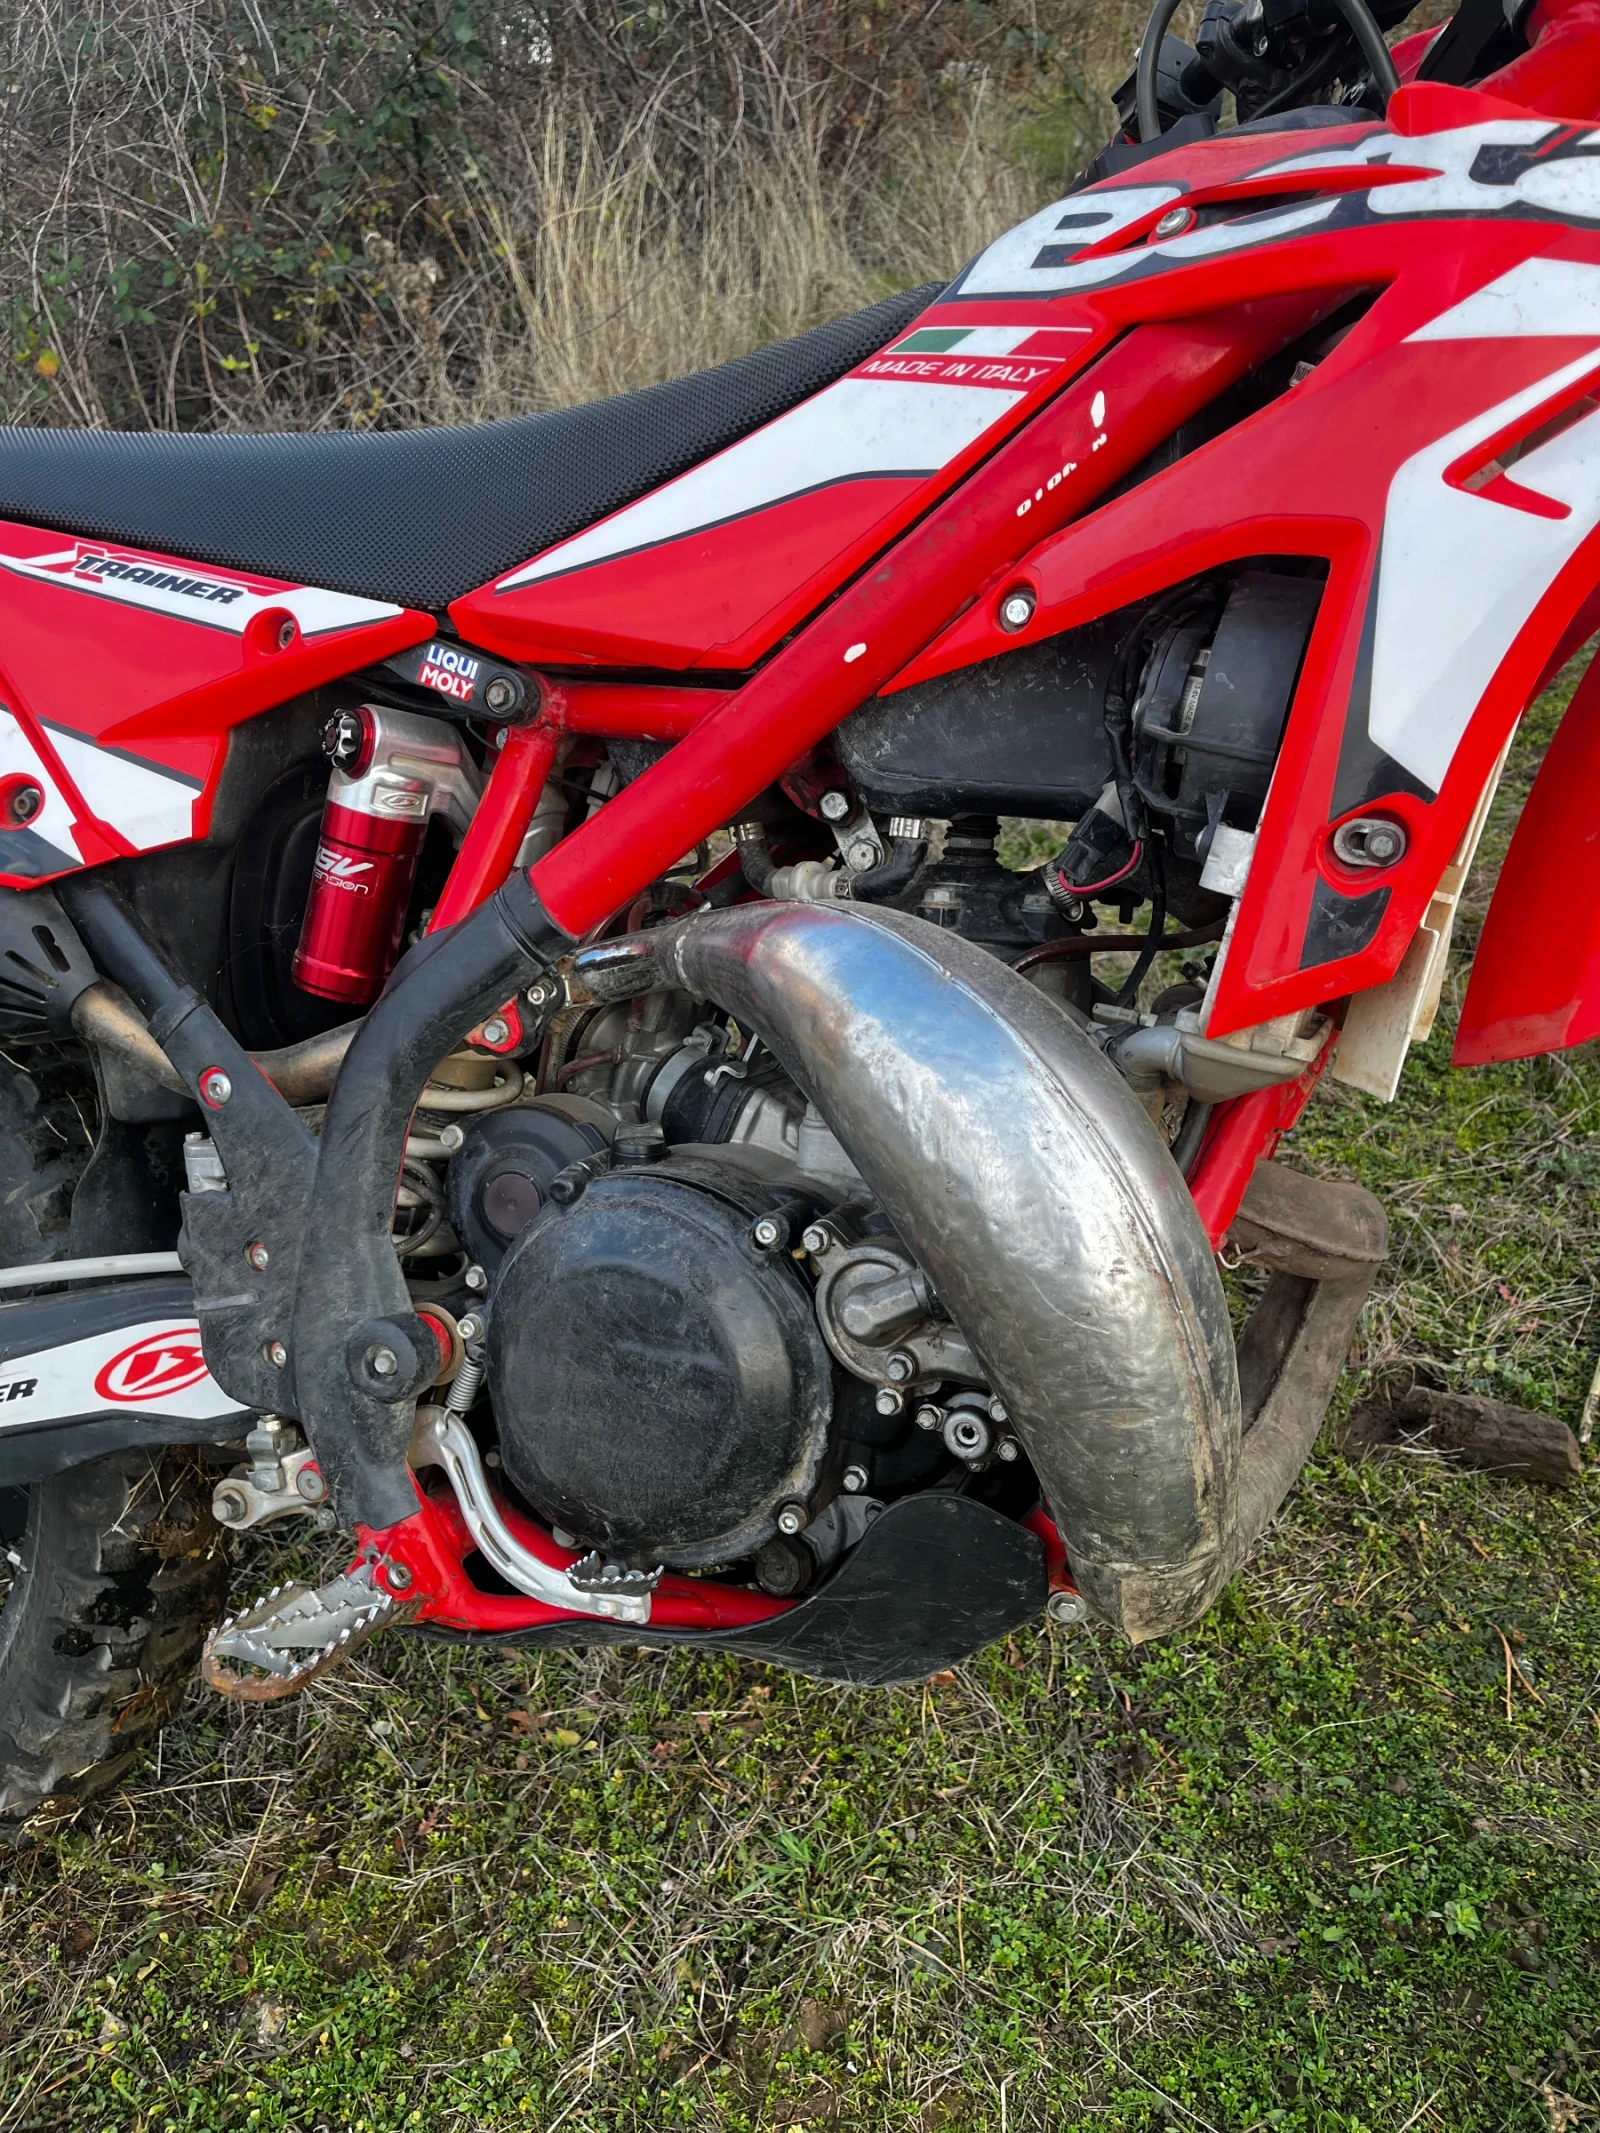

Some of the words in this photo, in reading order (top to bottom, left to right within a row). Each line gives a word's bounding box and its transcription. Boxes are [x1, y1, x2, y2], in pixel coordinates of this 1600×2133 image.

[861, 360, 938, 376] MADE
[940, 363, 970, 378] IN
[971, 364, 1050, 383] ITALY
[426, 644, 479, 680] LIQUI
[420, 665, 474, 699] MOLY
[1185, 700, 1196, 721] MADE
